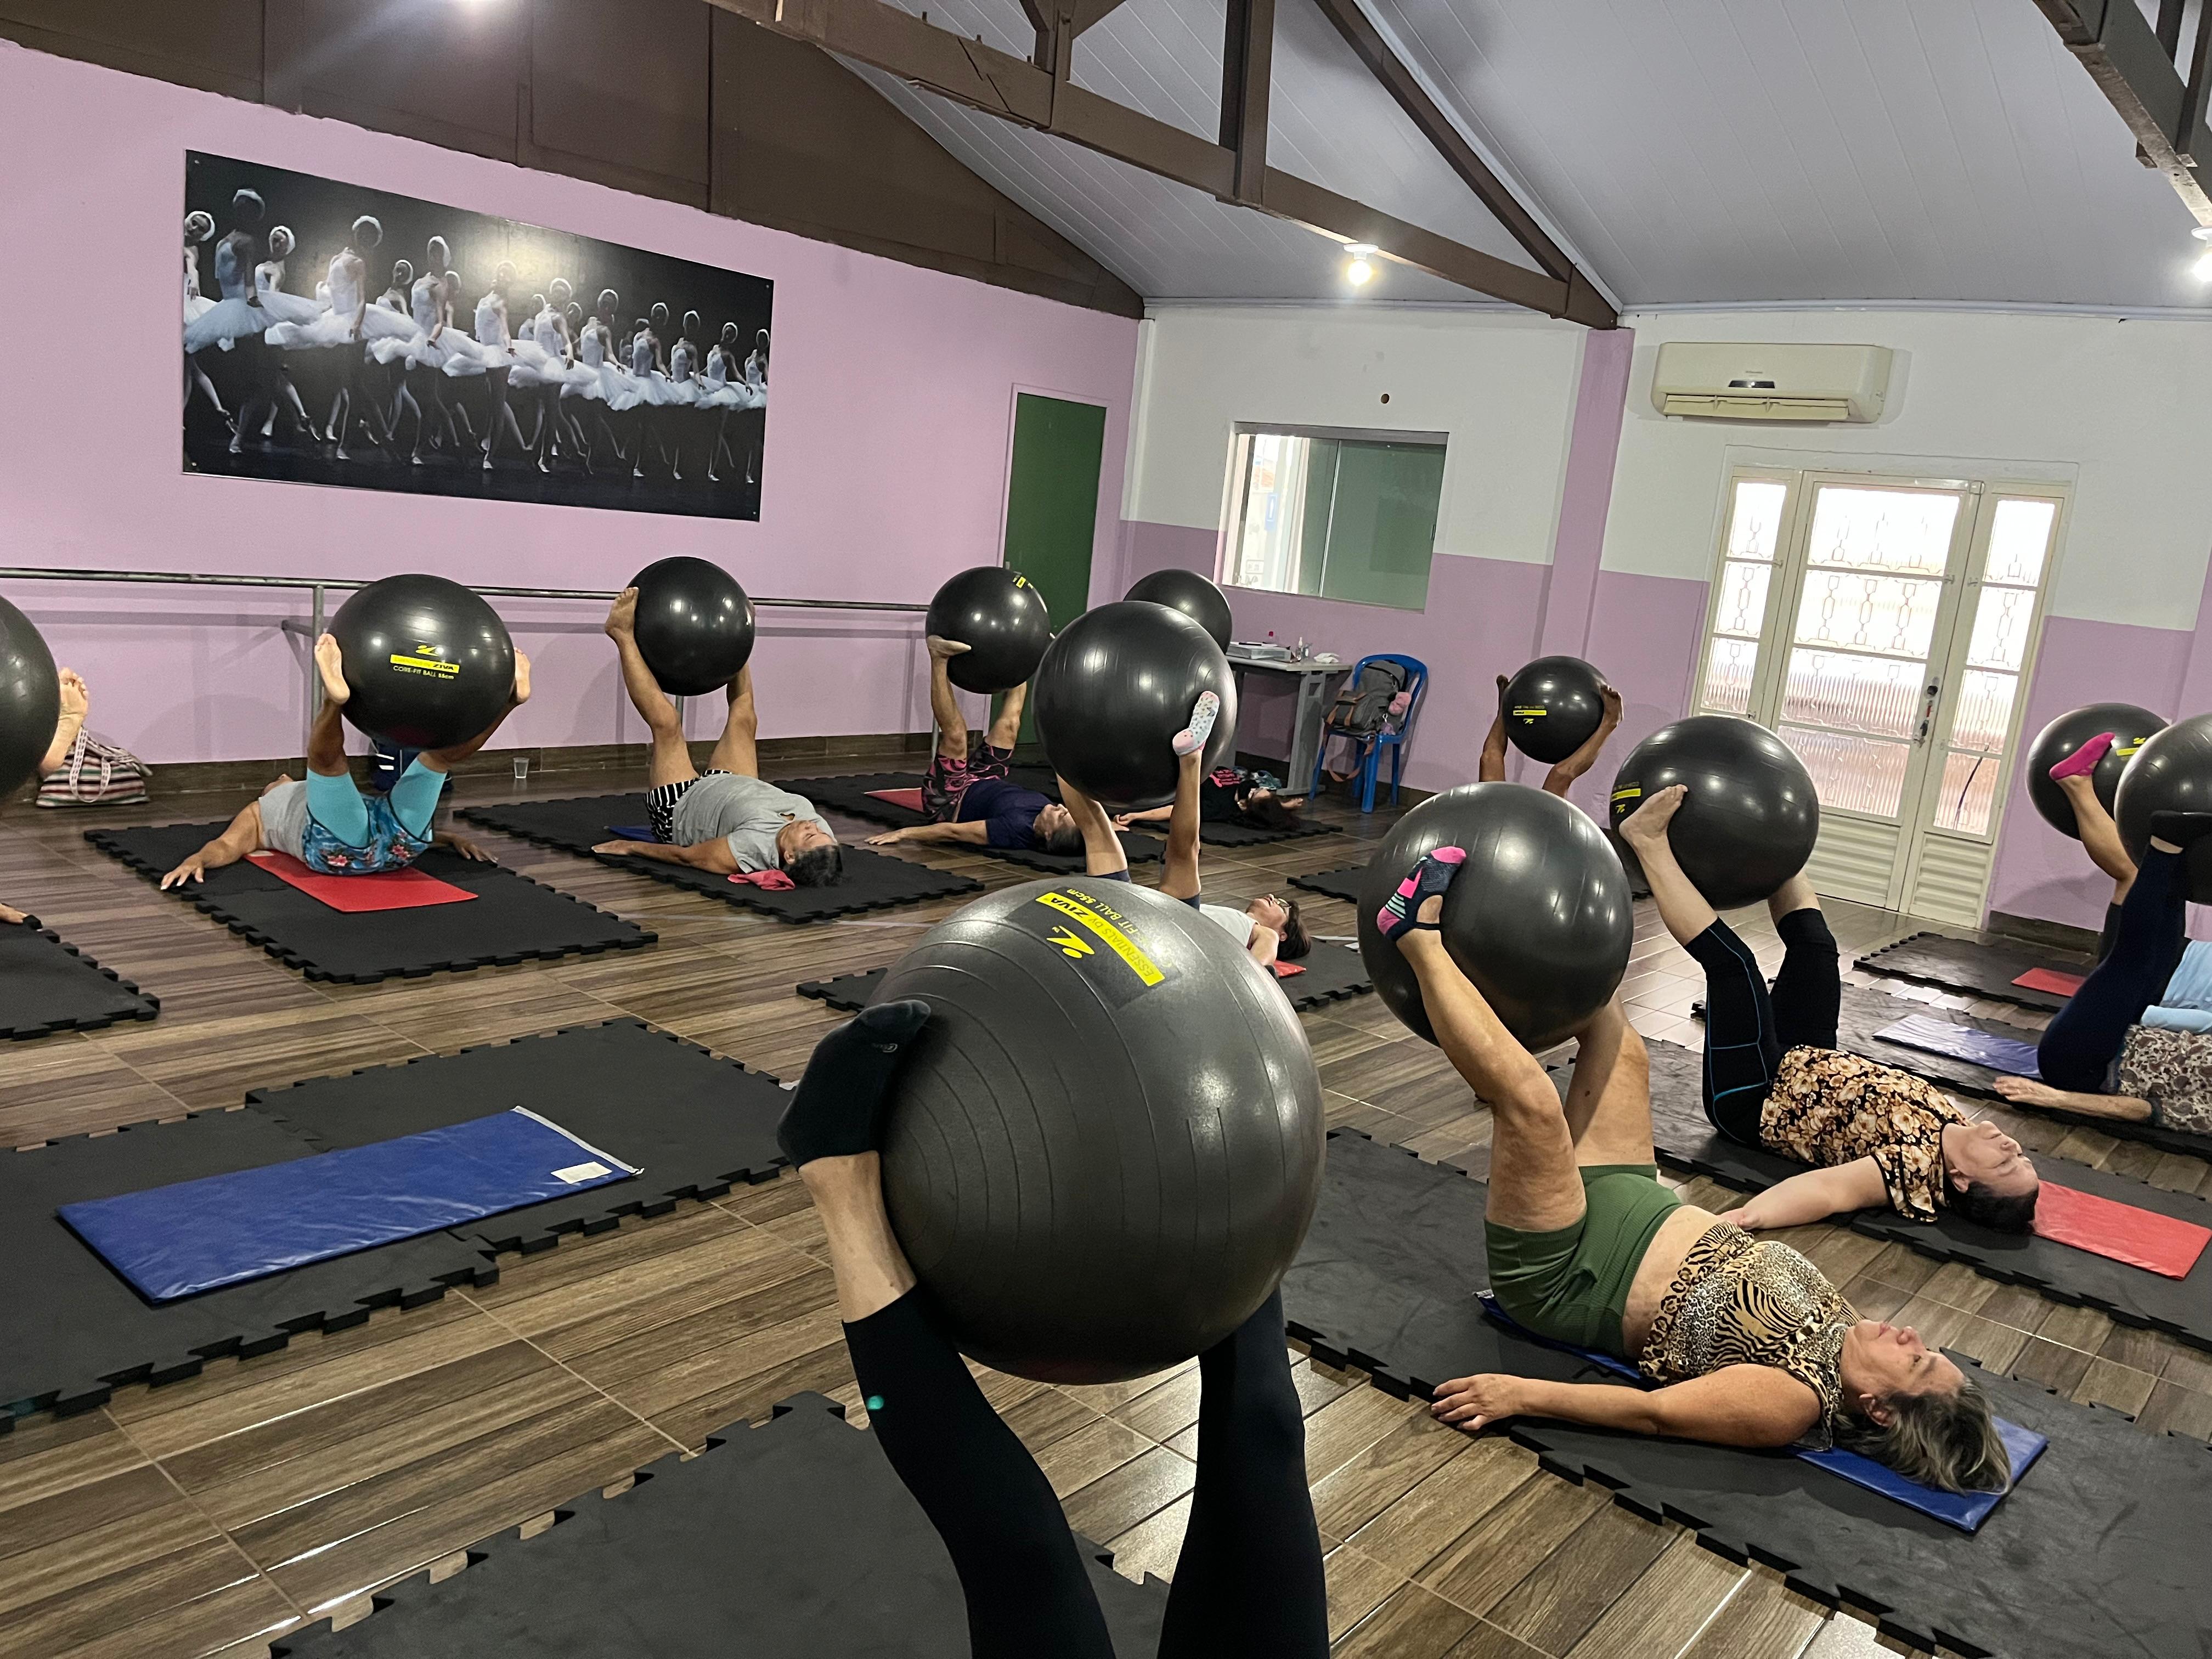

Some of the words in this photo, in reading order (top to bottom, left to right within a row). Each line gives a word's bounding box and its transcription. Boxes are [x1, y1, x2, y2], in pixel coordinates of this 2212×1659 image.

[1051, 897, 1089, 918] ZIVA
[1094, 902, 1122, 921] BALL
[1102, 928, 1154, 977] ESSENTIALS
